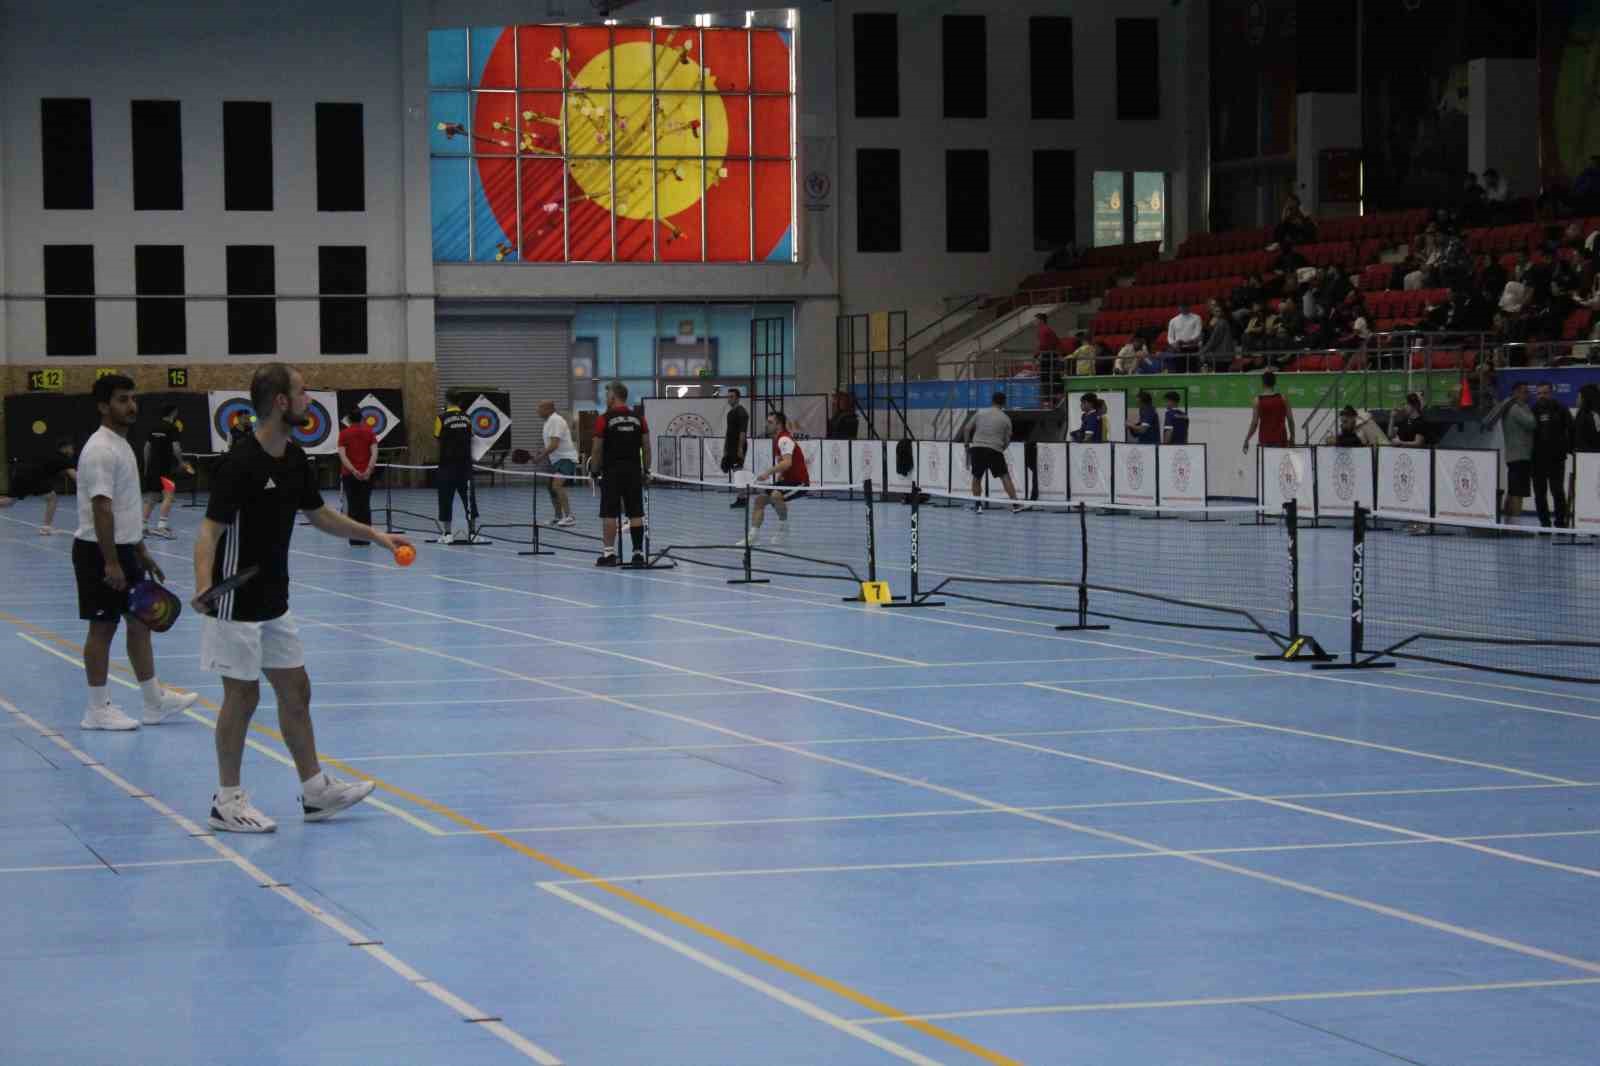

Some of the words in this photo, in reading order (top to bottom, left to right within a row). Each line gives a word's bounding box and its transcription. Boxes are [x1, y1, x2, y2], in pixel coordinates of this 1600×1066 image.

[46, 372, 59, 386] 12
[171, 371, 185, 385] 15
[1353, 543, 1363, 608] JOOLA
[872, 585, 880, 600] 7
